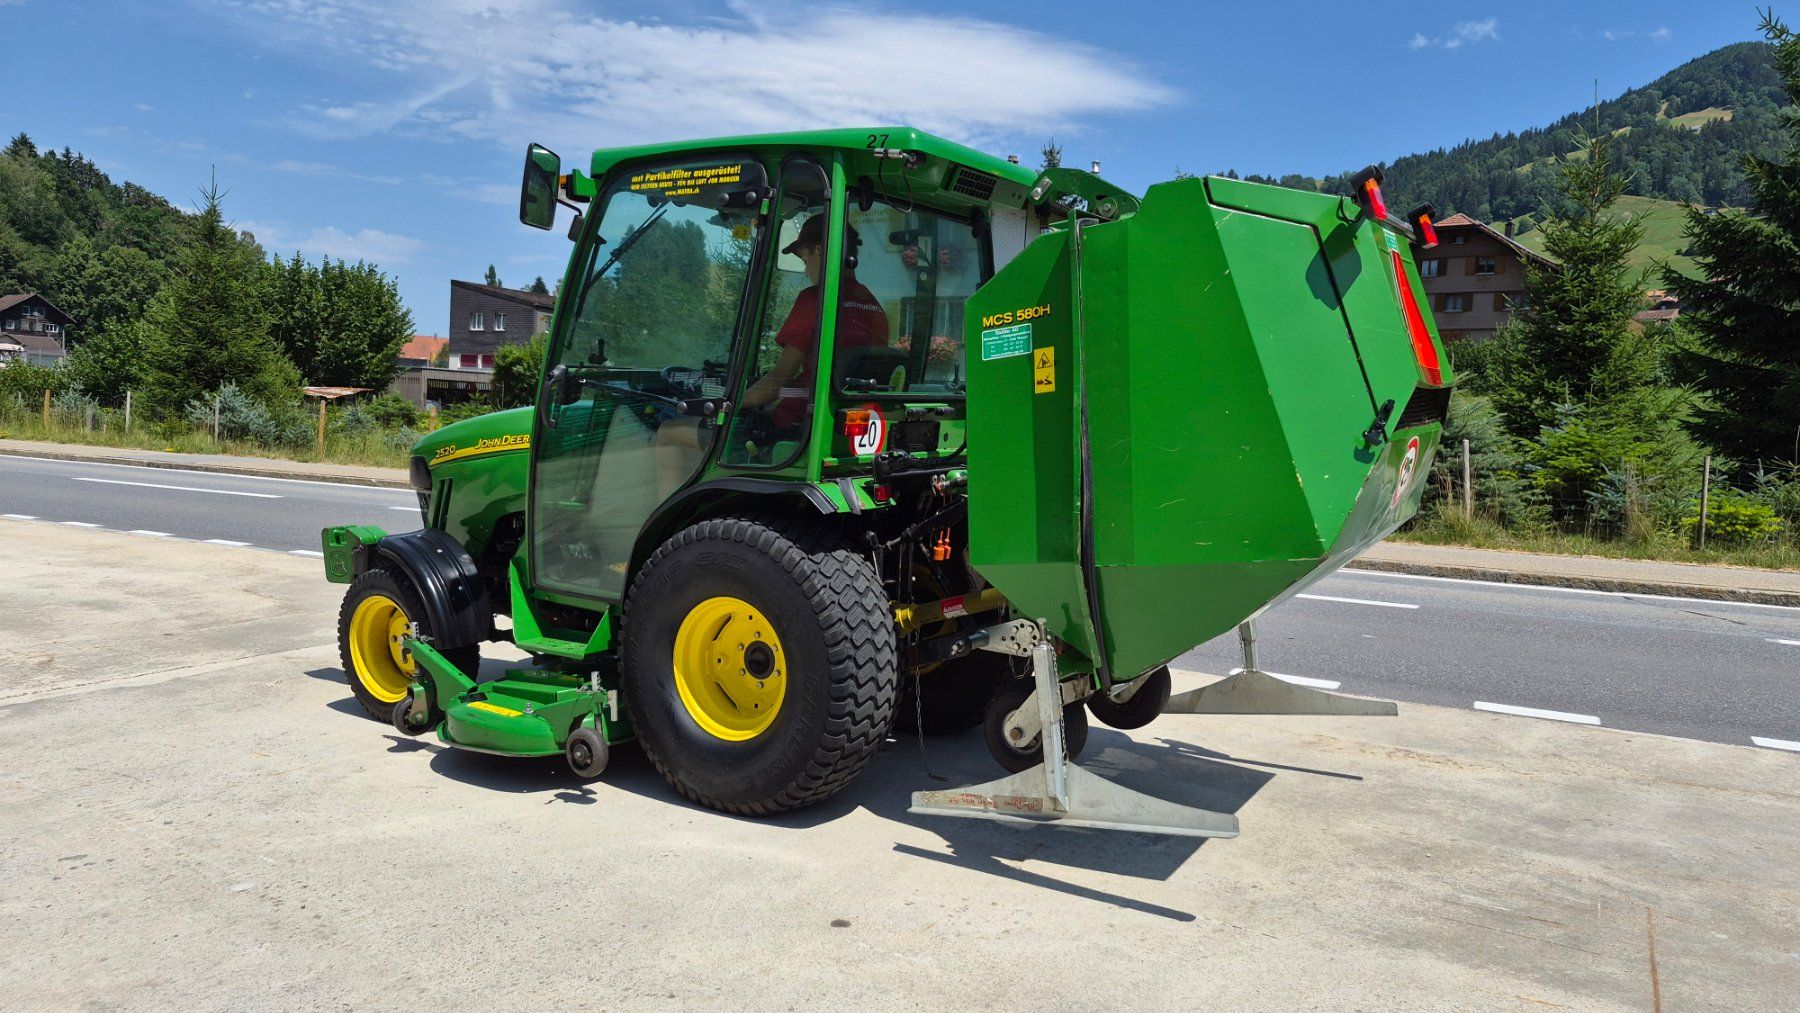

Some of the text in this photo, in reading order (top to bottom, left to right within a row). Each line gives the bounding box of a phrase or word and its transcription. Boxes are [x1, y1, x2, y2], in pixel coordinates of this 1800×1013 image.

[866, 134, 889, 148] 27
[645, 169, 692, 181] Partikelfilter
[693, 164, 741, 178] ausgerüstet!
[983, 304, 1051, 327] MCS 580H
[474, 434, 531, 450] JOHN DEER
[435, 445, 456, 458] 2520
